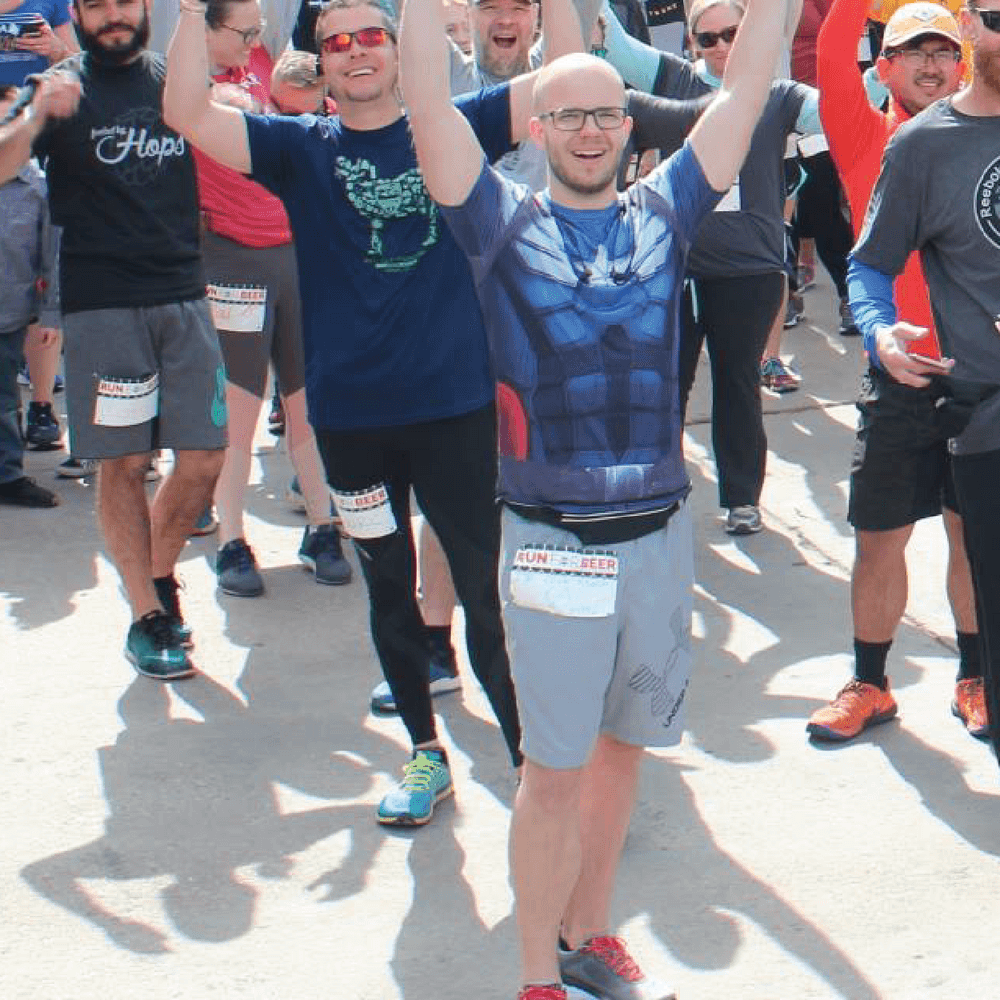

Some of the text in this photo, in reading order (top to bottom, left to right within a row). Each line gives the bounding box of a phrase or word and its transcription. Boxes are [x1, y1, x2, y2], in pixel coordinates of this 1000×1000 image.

[96, 126, 185, 167] Hops
[99, 382, 123, 392] RUN
[516, 551, 550, 564] RUN
[580, 557, 618, 571] BEER
